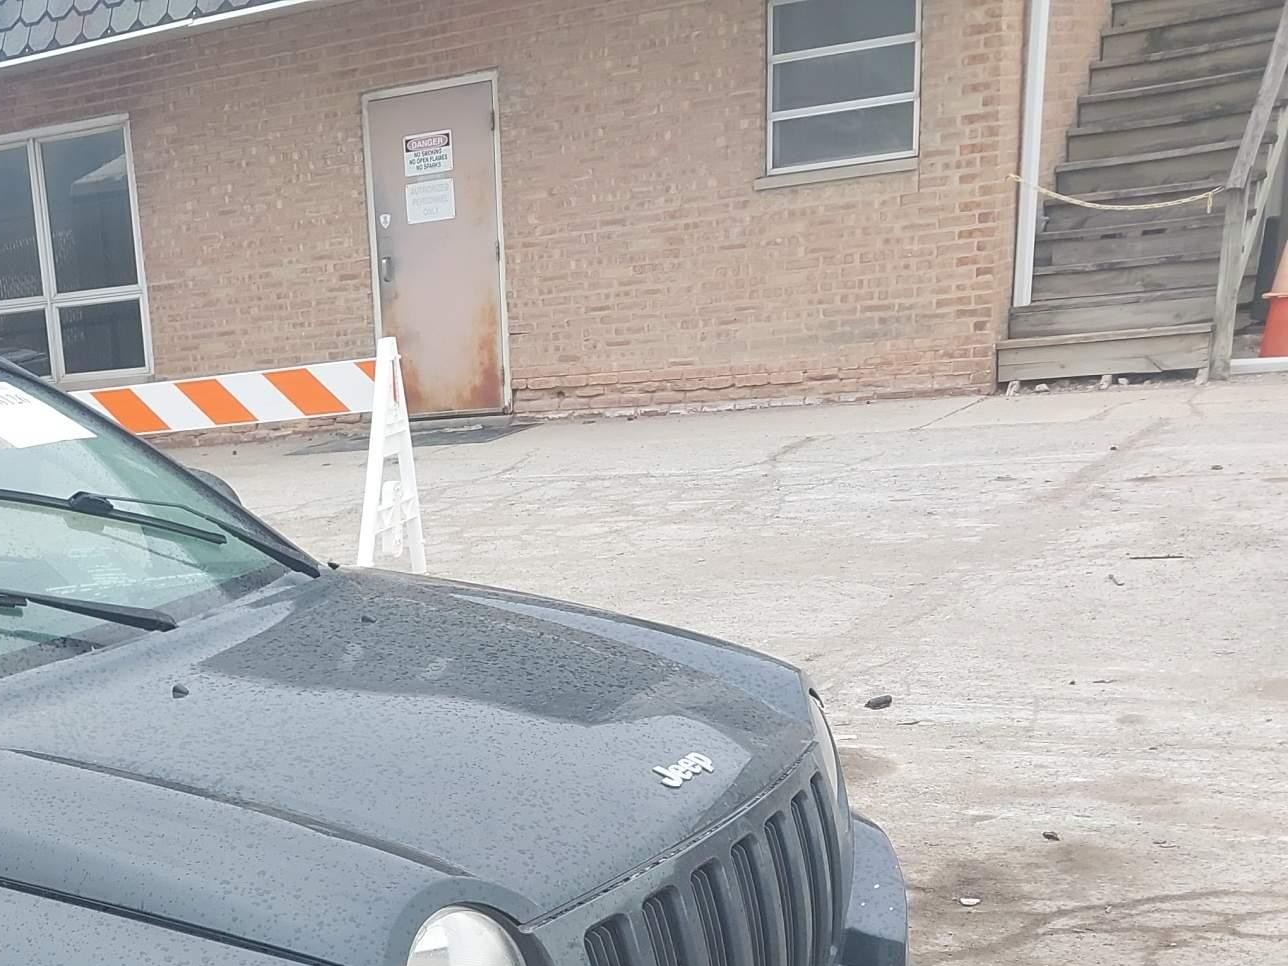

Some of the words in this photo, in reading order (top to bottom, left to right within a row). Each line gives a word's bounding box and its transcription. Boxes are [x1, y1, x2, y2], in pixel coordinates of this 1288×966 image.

[411, 137, 444, 149] DANGER
[422, 148, 442, 157] SMOKING
[417, 157, 428, 165] OPEN
[429, 153, 448, 162] FLAMES
[424, 161, 441, 170] SPARKS
[652, 752, 714, 788] Jeep
